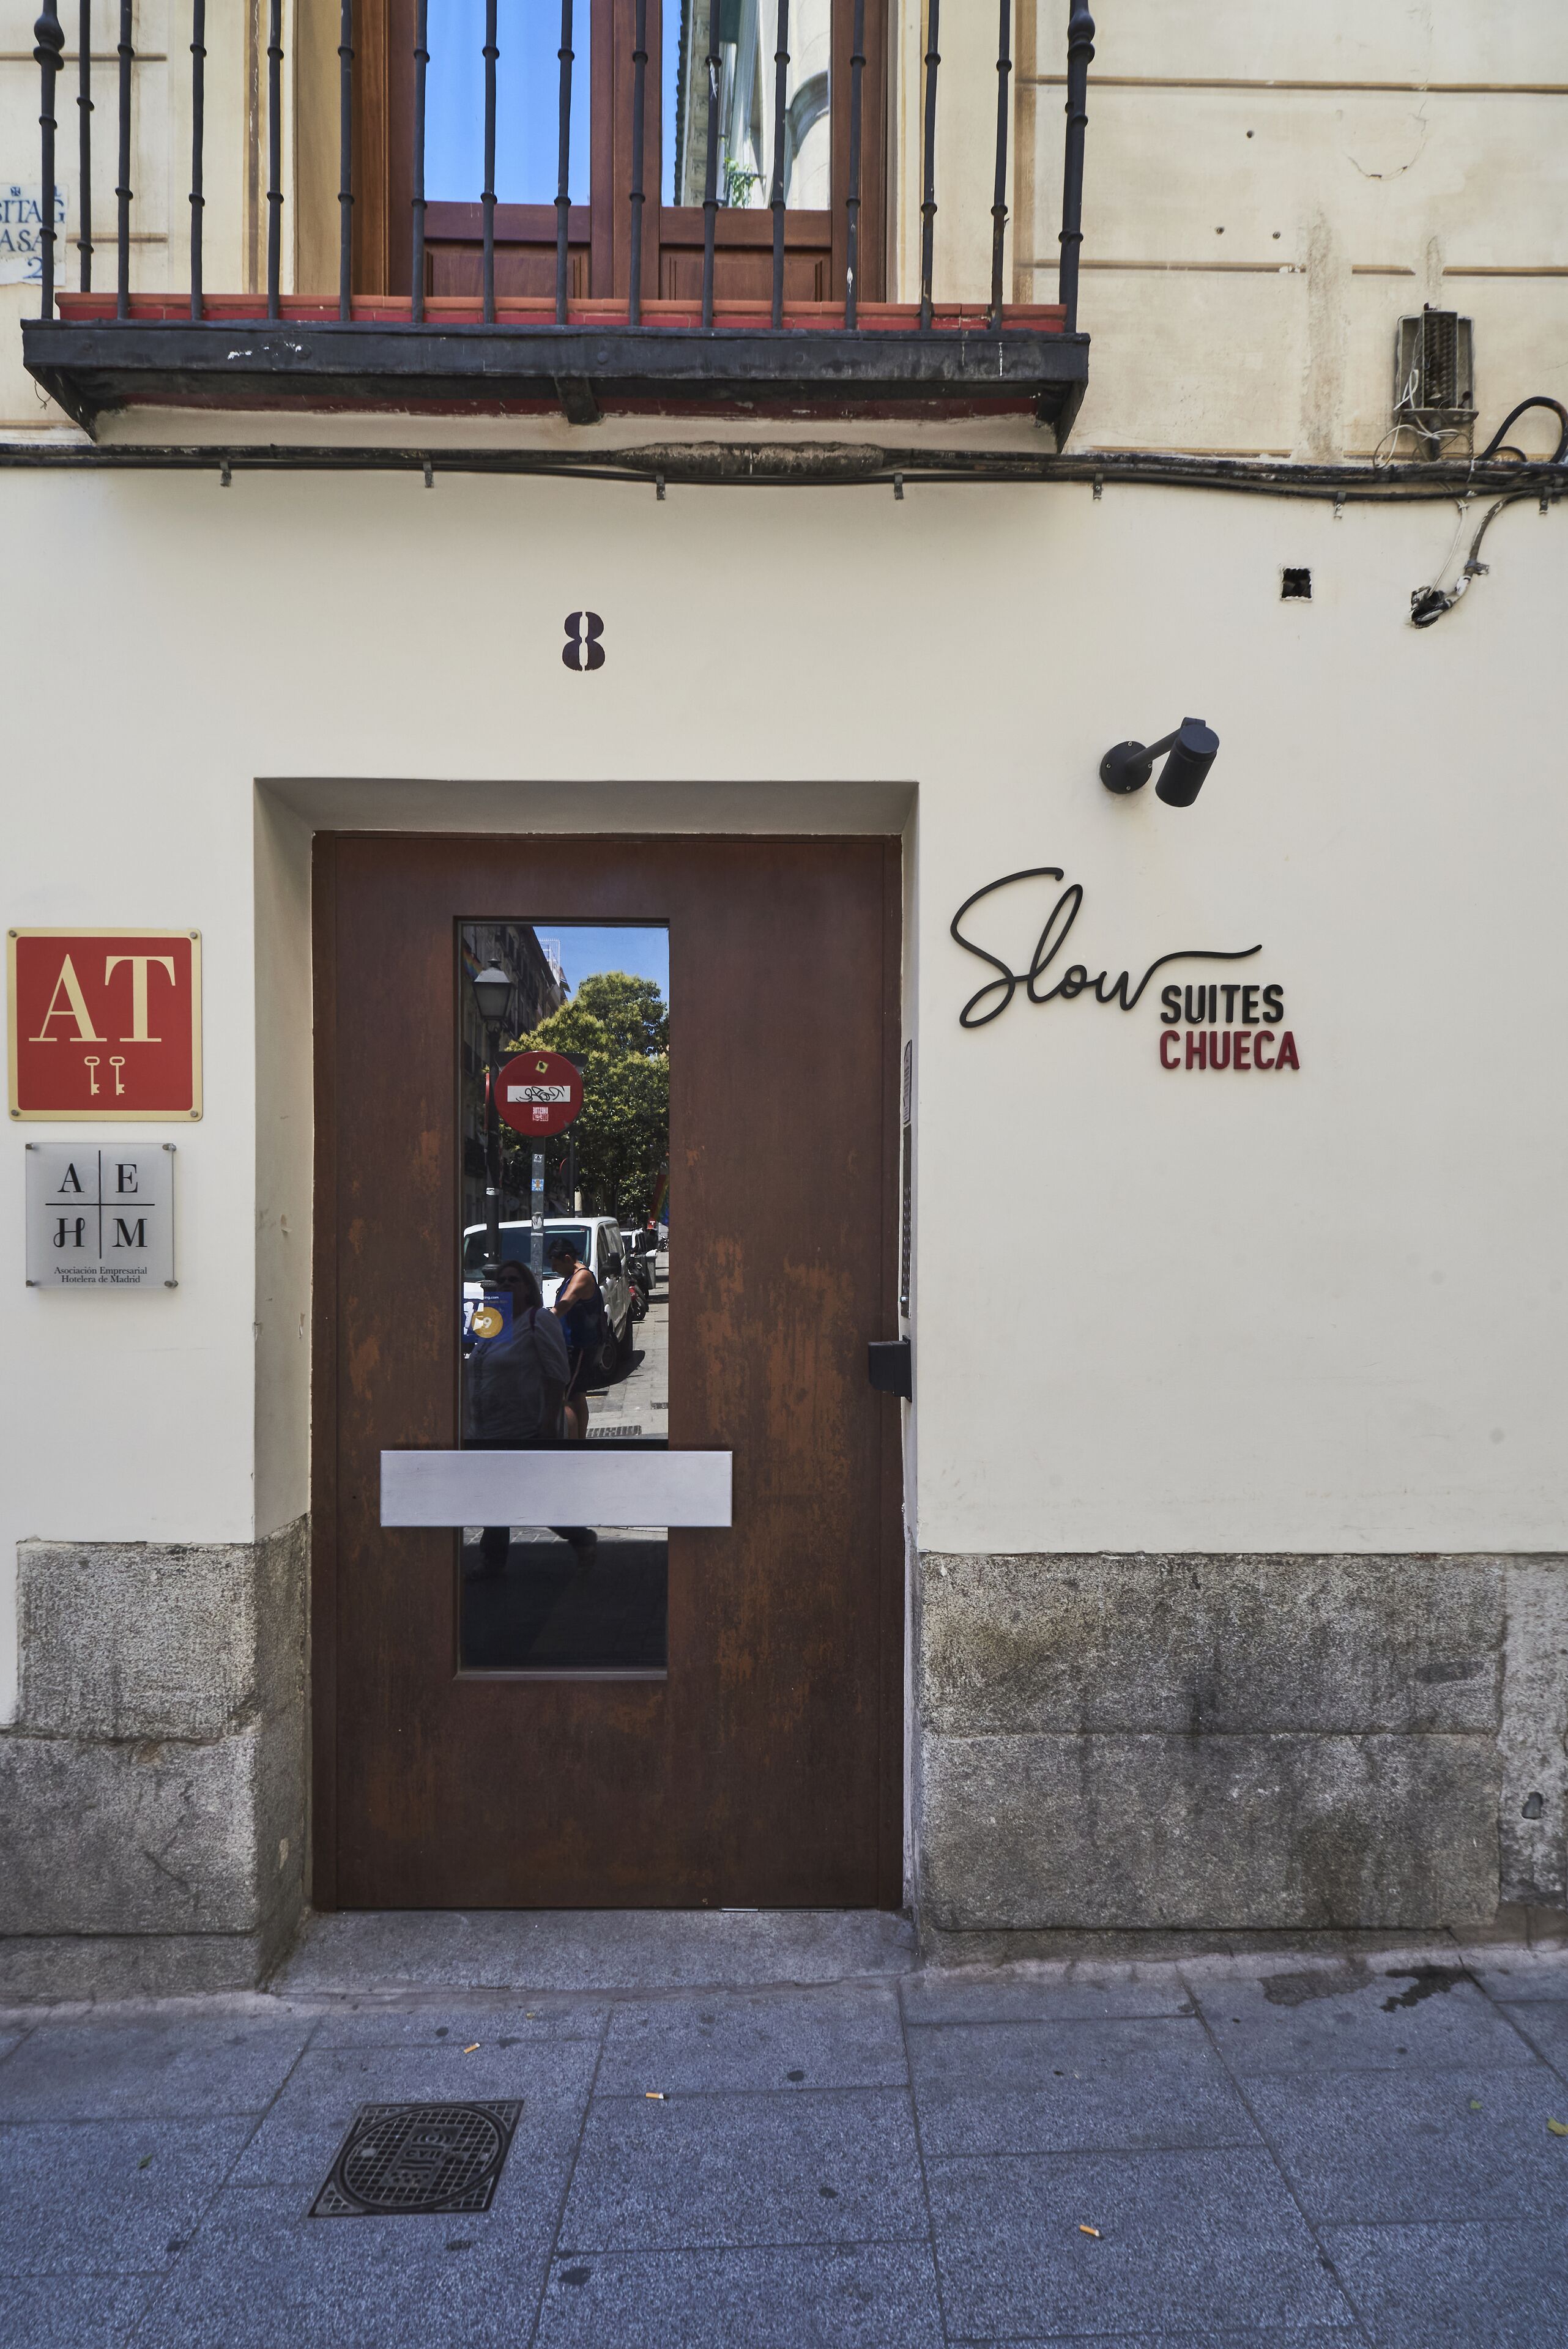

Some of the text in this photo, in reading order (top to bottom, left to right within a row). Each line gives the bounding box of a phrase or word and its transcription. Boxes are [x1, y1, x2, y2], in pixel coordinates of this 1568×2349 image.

[23, 257, 42, 279] 2
[562, 611, 606, 672] 8
[950, 867, 1262, 1028] Slow
[28, 954, 176, 1042] AT
[1161, 984, 1284, 1024] SUITES
[1159, 1030, 1299, 1070] CHUECA
[57, 1163, 138, 1193] A E
[112, 1219, 147, 1248] M
[99, 1266, 147, 1276] Empresarial
